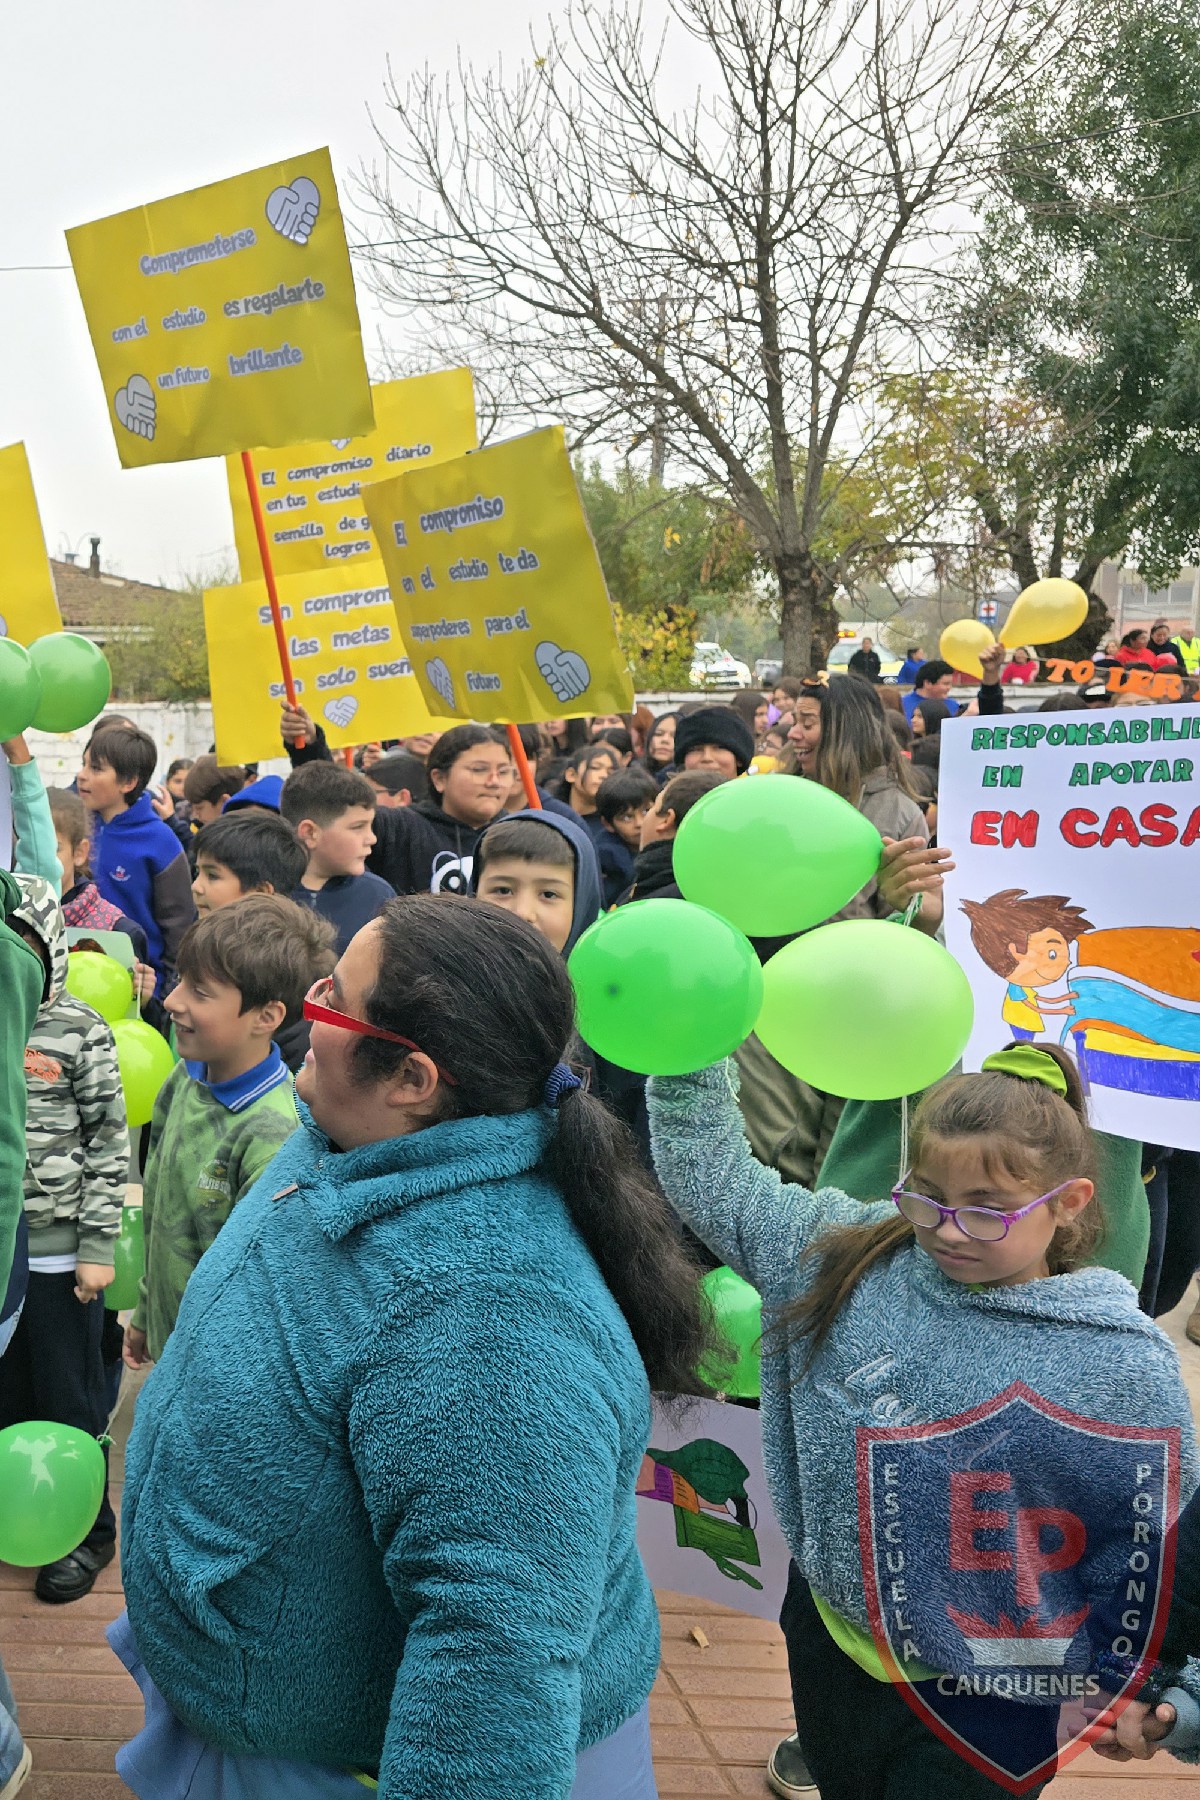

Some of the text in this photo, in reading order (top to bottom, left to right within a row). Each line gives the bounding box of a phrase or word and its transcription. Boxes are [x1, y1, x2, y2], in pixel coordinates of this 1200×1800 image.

[141, 229, 255, 274] Comprometerse
[112, 278, 324, 343] con el estudio es regalarte
[158, 374, 174, 387] un
[229, 344, 302, 374] brillante
[261, 444, 431, 485] El compromiso diario
[266, 483, 361, 512] en tus estudi
[420, 497, 504, 532] compromiso
[274, 525, 324, 541] semilla
[340, 517, 357, 530] de
[420, 566, 435, 590] el
[449, 560, 489, 580] estudio
[499, 552, 515, 572] te
[517, 549, 539, 570] da
[259, 588, 391, 623] Sn comprom
[484, 616, 513, 638] para
[515, 608, 529, 629] el
[292, 625, 390, 656] las metas
[318, 667, 356, 688] solo
[368, 658, 410, 678] sueñ
[982, 758, 1194, 787] EN APOYAR
[970, 809, 1039, 848] EN
